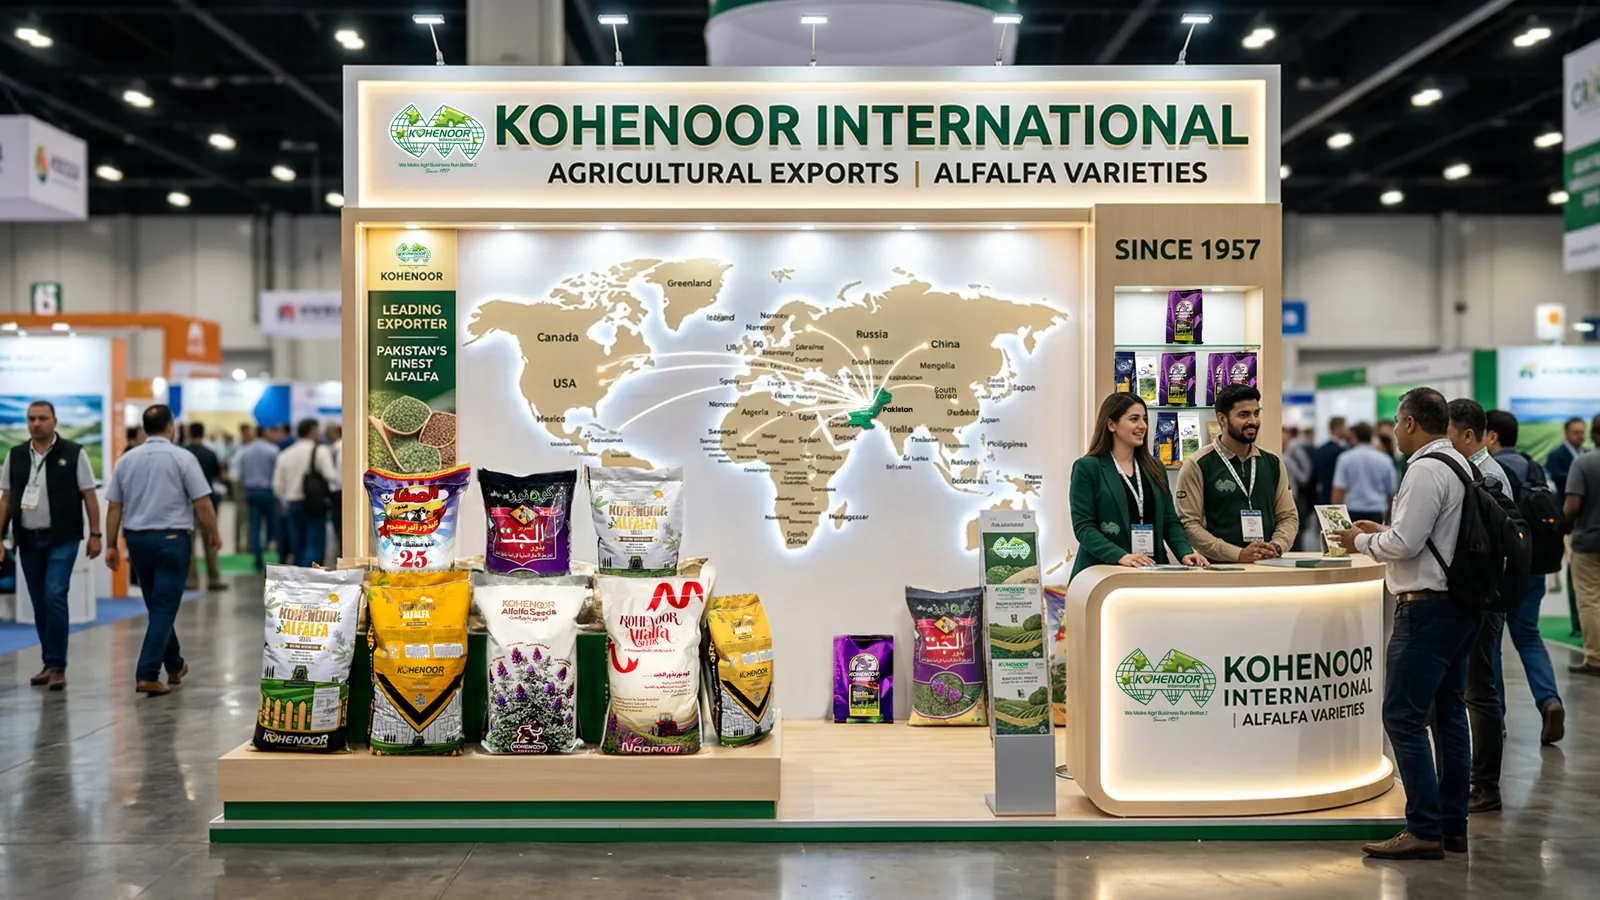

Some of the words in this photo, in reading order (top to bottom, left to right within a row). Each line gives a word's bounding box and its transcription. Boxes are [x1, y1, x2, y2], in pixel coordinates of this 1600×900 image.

[495, 104, 800, 146] KOHENOOR
[817, 104, 1249, 146] INTERNATIONAL
[408, 129, 470, 137] KOHENOOR
[548, 162, 762, 184] AGRICULTURAL
[770, 162, 899, 184] EXPORTS
[934, 162, 1056, 183] ALFALFA
[1064, 162, 1208, 183] VARIETIES
[1115, 239, 1193, 260] SINCE
[1200, 239, 1261, 260] 1957
[381, 272, 443, 281] KOHENOOR
[667, 279, 712, 288] Greenland
[383, 304, 442, 315] LEADING
[377, 318, 447, 329] EXPORTER
[537, 332, 579, 342] Canada
[856, 330, 888, 339] Russia
[931, 340, 960, 349] China
[377, 345, 447, 356] PAKISTAN'S
[391, 359, 433, 368] FINEST
[385, 372, 439, 382] ALFALFA
[553, 379, 577, 388] USA
[394, 485, 438, 503] الصفا
[399, 550, 428, 568] 25
[502, 600, 555, 609] KOHENOOR
[530, 608, 557, 616] Seeds
[283, 620, 329, 637] ALFALFA
[1224, 646, 1372, 683] KOHENOOR
[397, 666, 444, 674] KOHENOOR
[1135, 675, 1201, 683] KOHENOOR
[1224, 677, 1372, 706] INTERNATIONAL
[1242, 710, 1308, 726] ALFALFA
[1310, 702, 1365, 723] VARIETIES
[263, 732, 328, 745] KOHENOOR
